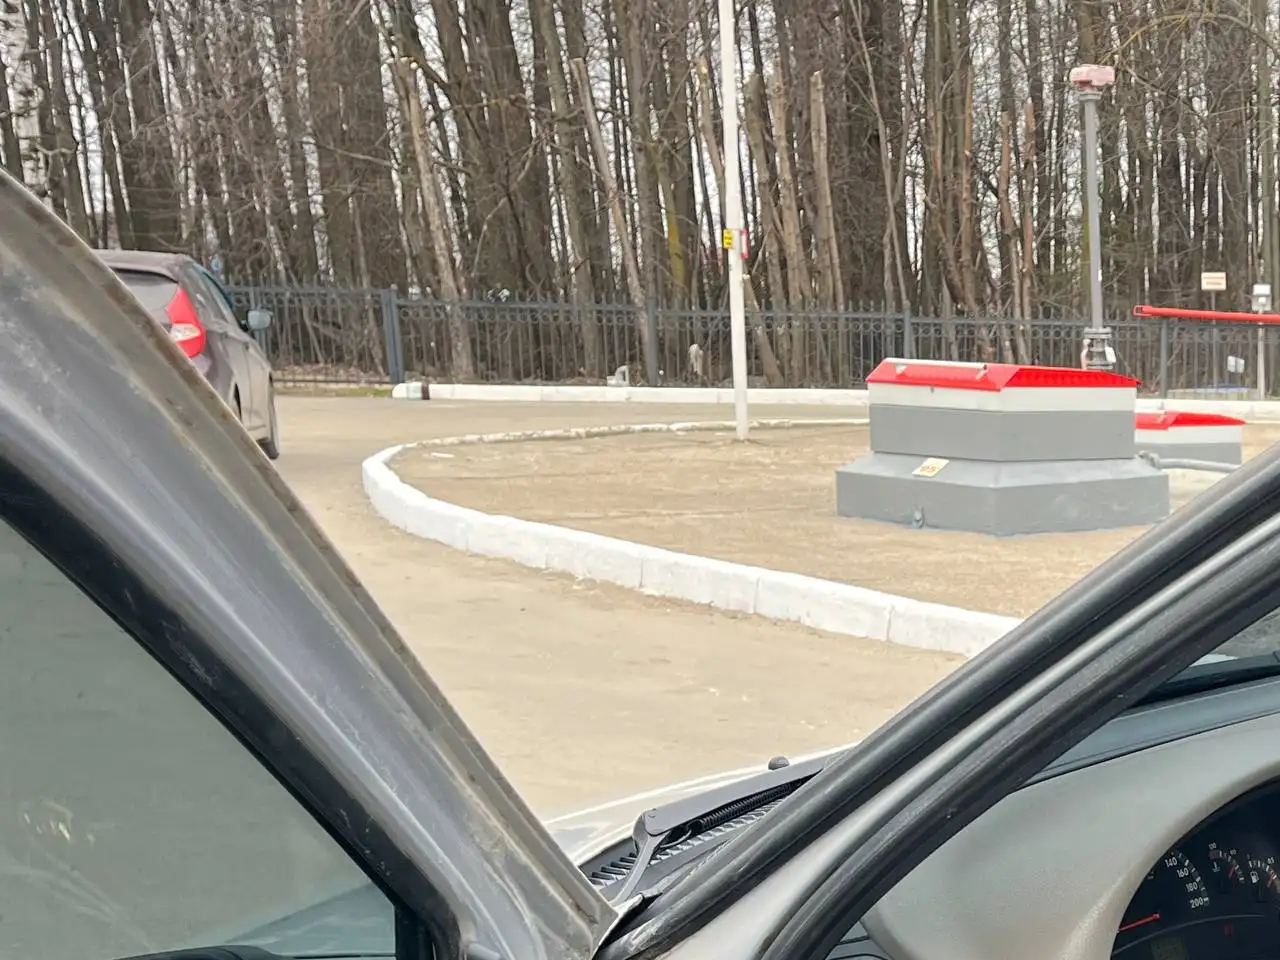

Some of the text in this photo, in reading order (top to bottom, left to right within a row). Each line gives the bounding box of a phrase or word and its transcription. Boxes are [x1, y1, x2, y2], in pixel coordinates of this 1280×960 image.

[1164, 856, 1178, 868] 140
[1176, 867, 1189, 878] 160
[1185, 881, 1198, 893] 180
[1189, 896, 1204, 909] 200
